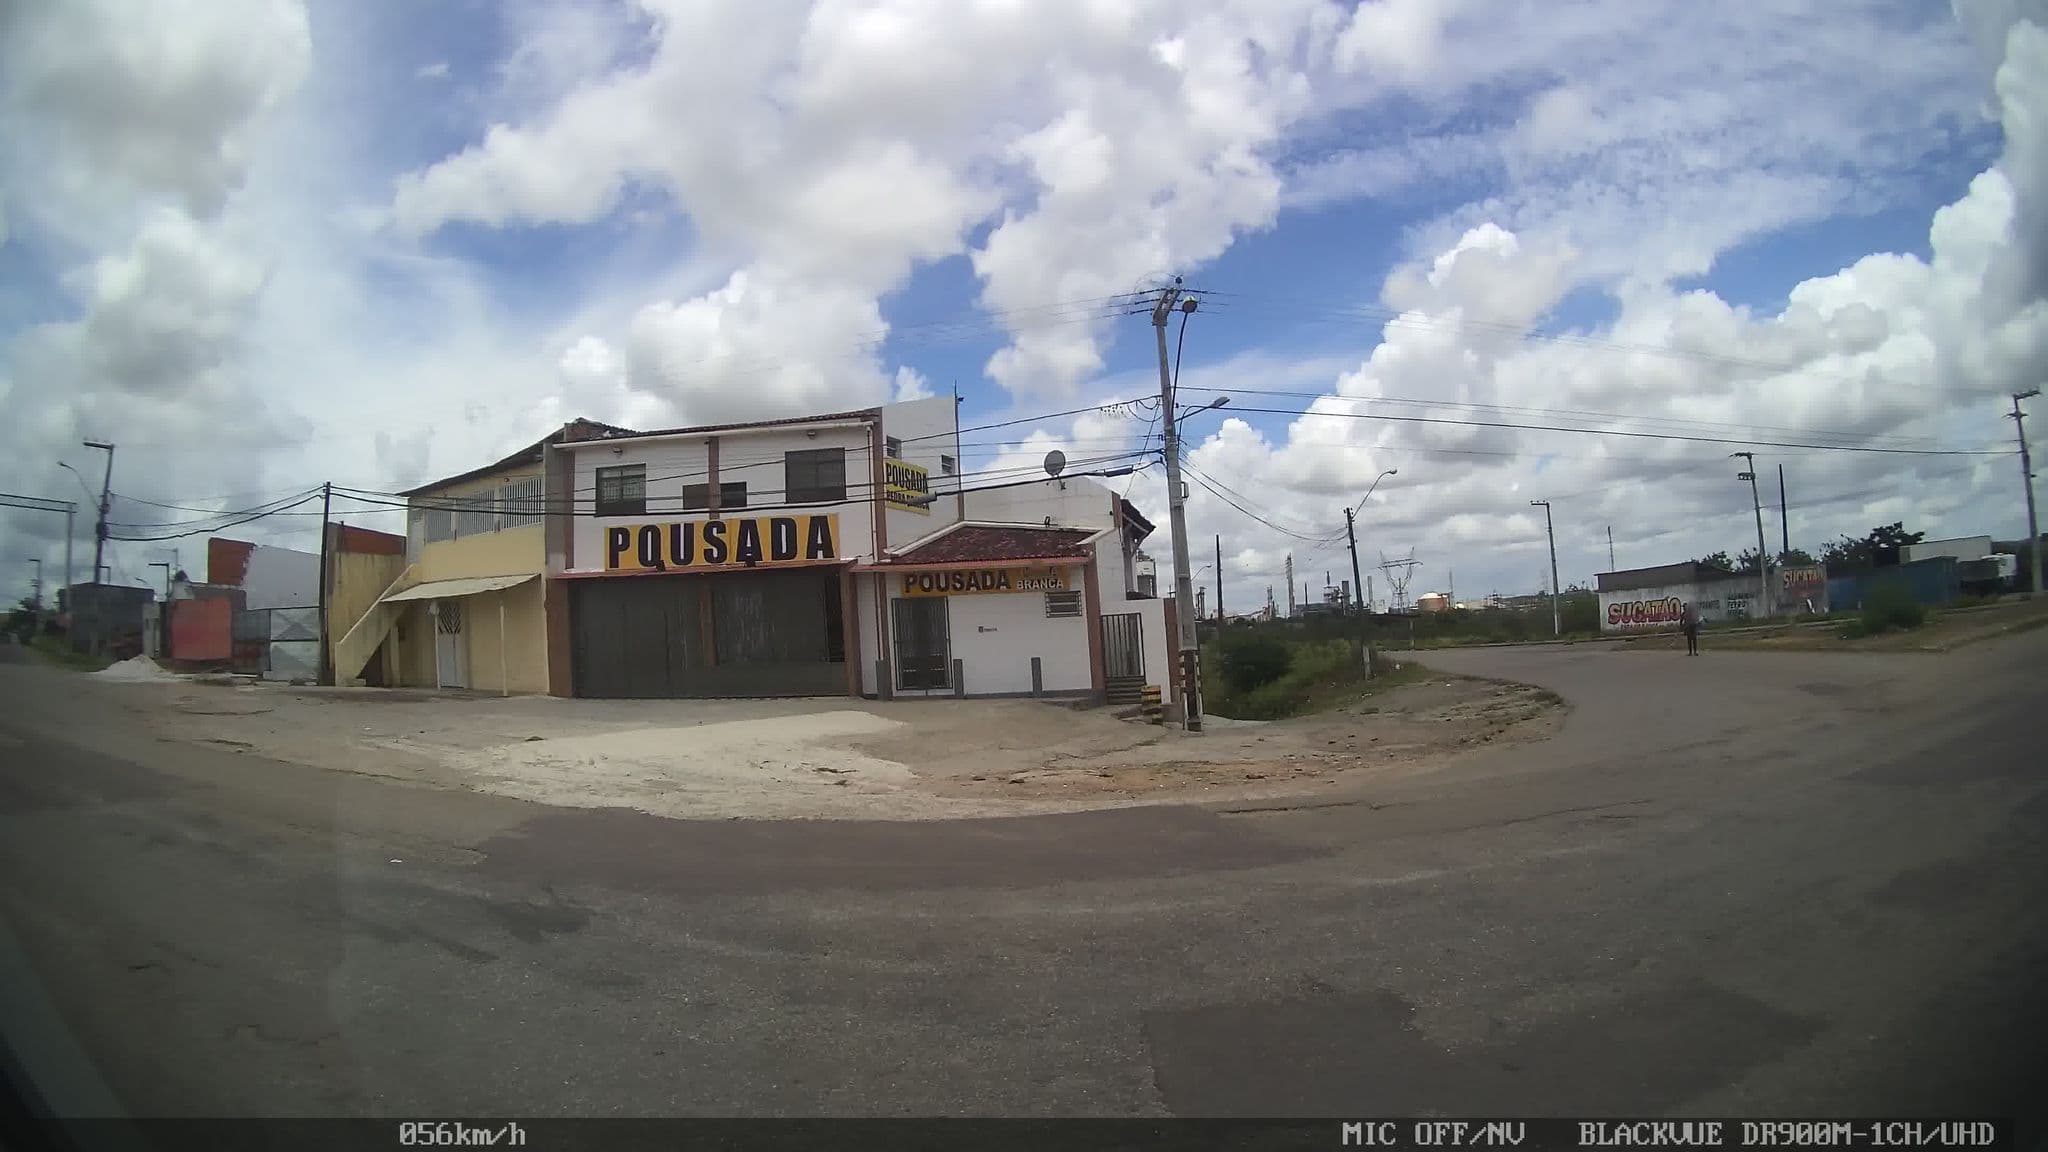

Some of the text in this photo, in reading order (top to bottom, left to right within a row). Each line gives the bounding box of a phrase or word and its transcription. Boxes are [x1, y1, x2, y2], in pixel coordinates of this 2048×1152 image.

[886, 462, 929, 494] POUSADA
[609, 515, 835, 568] POUSADA
[904, 569, 1011, 593] POUSADA
[1016, 578, 1064, 590] BRANCA
